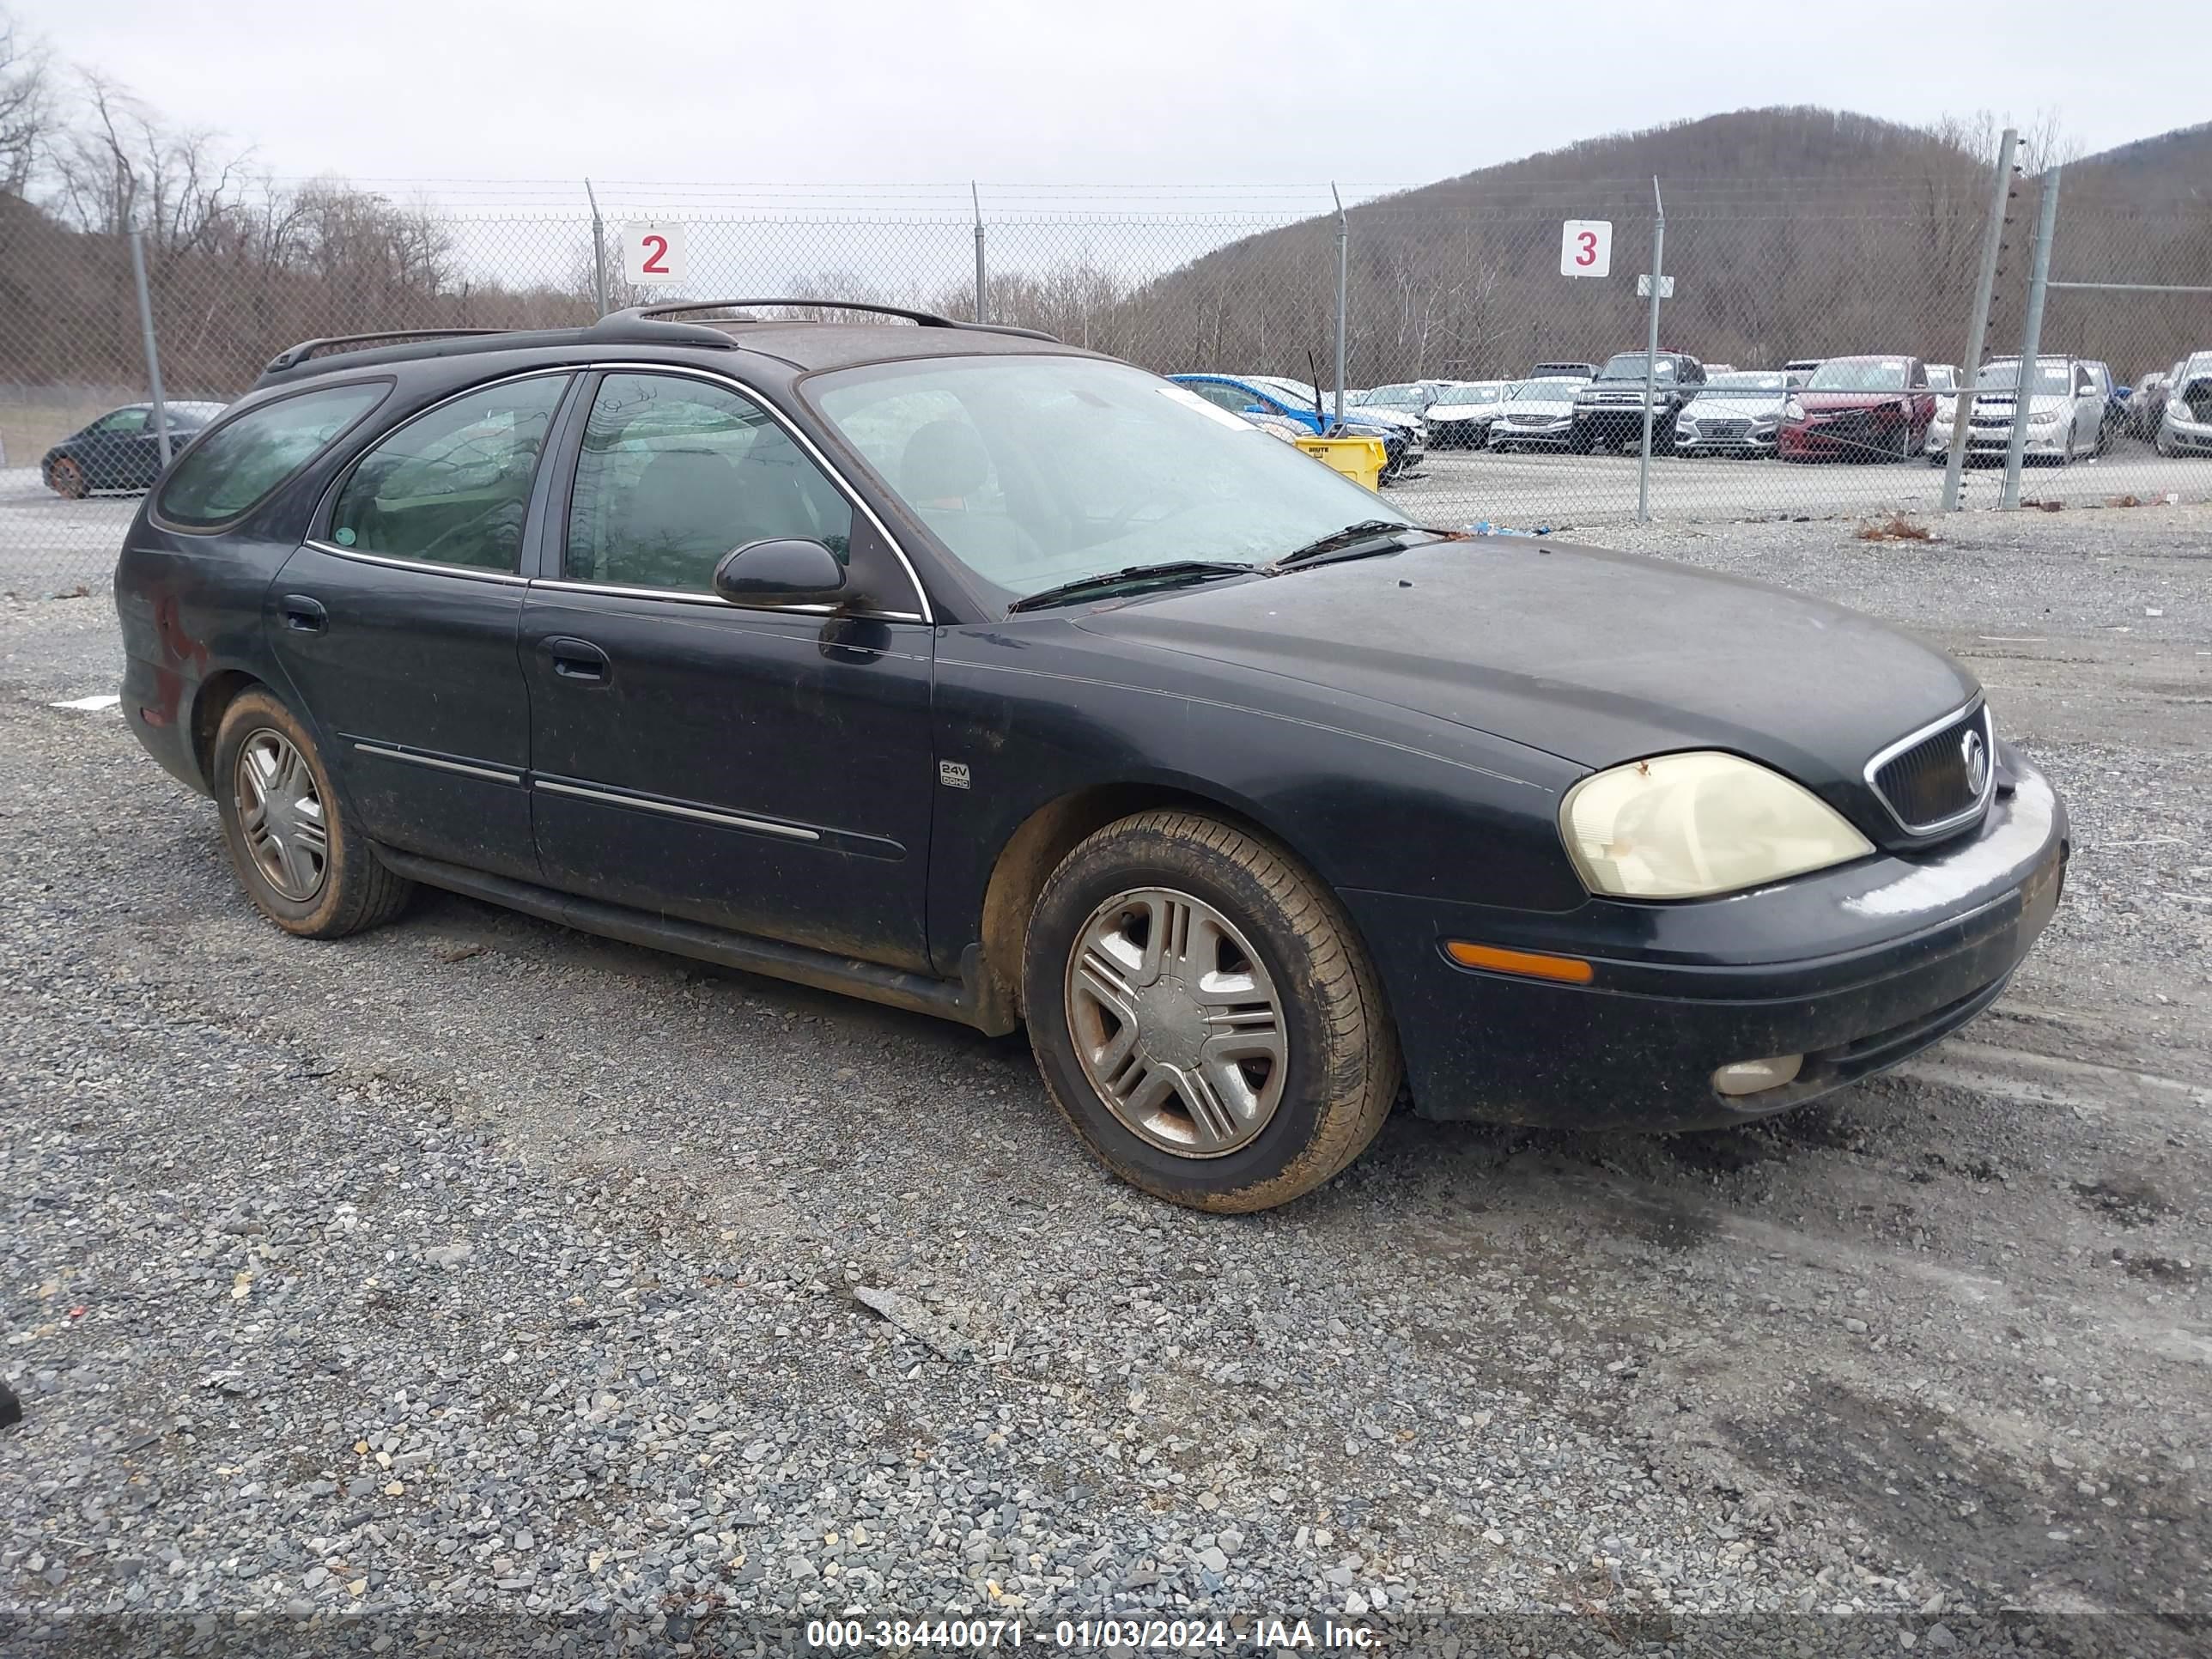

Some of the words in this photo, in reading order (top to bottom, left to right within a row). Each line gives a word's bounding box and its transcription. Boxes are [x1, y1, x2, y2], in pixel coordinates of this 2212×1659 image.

[642, 235, 669, 273] 2
[1576, 232, 1597, 266] 3
[942, 764, 967, 776] 24V
